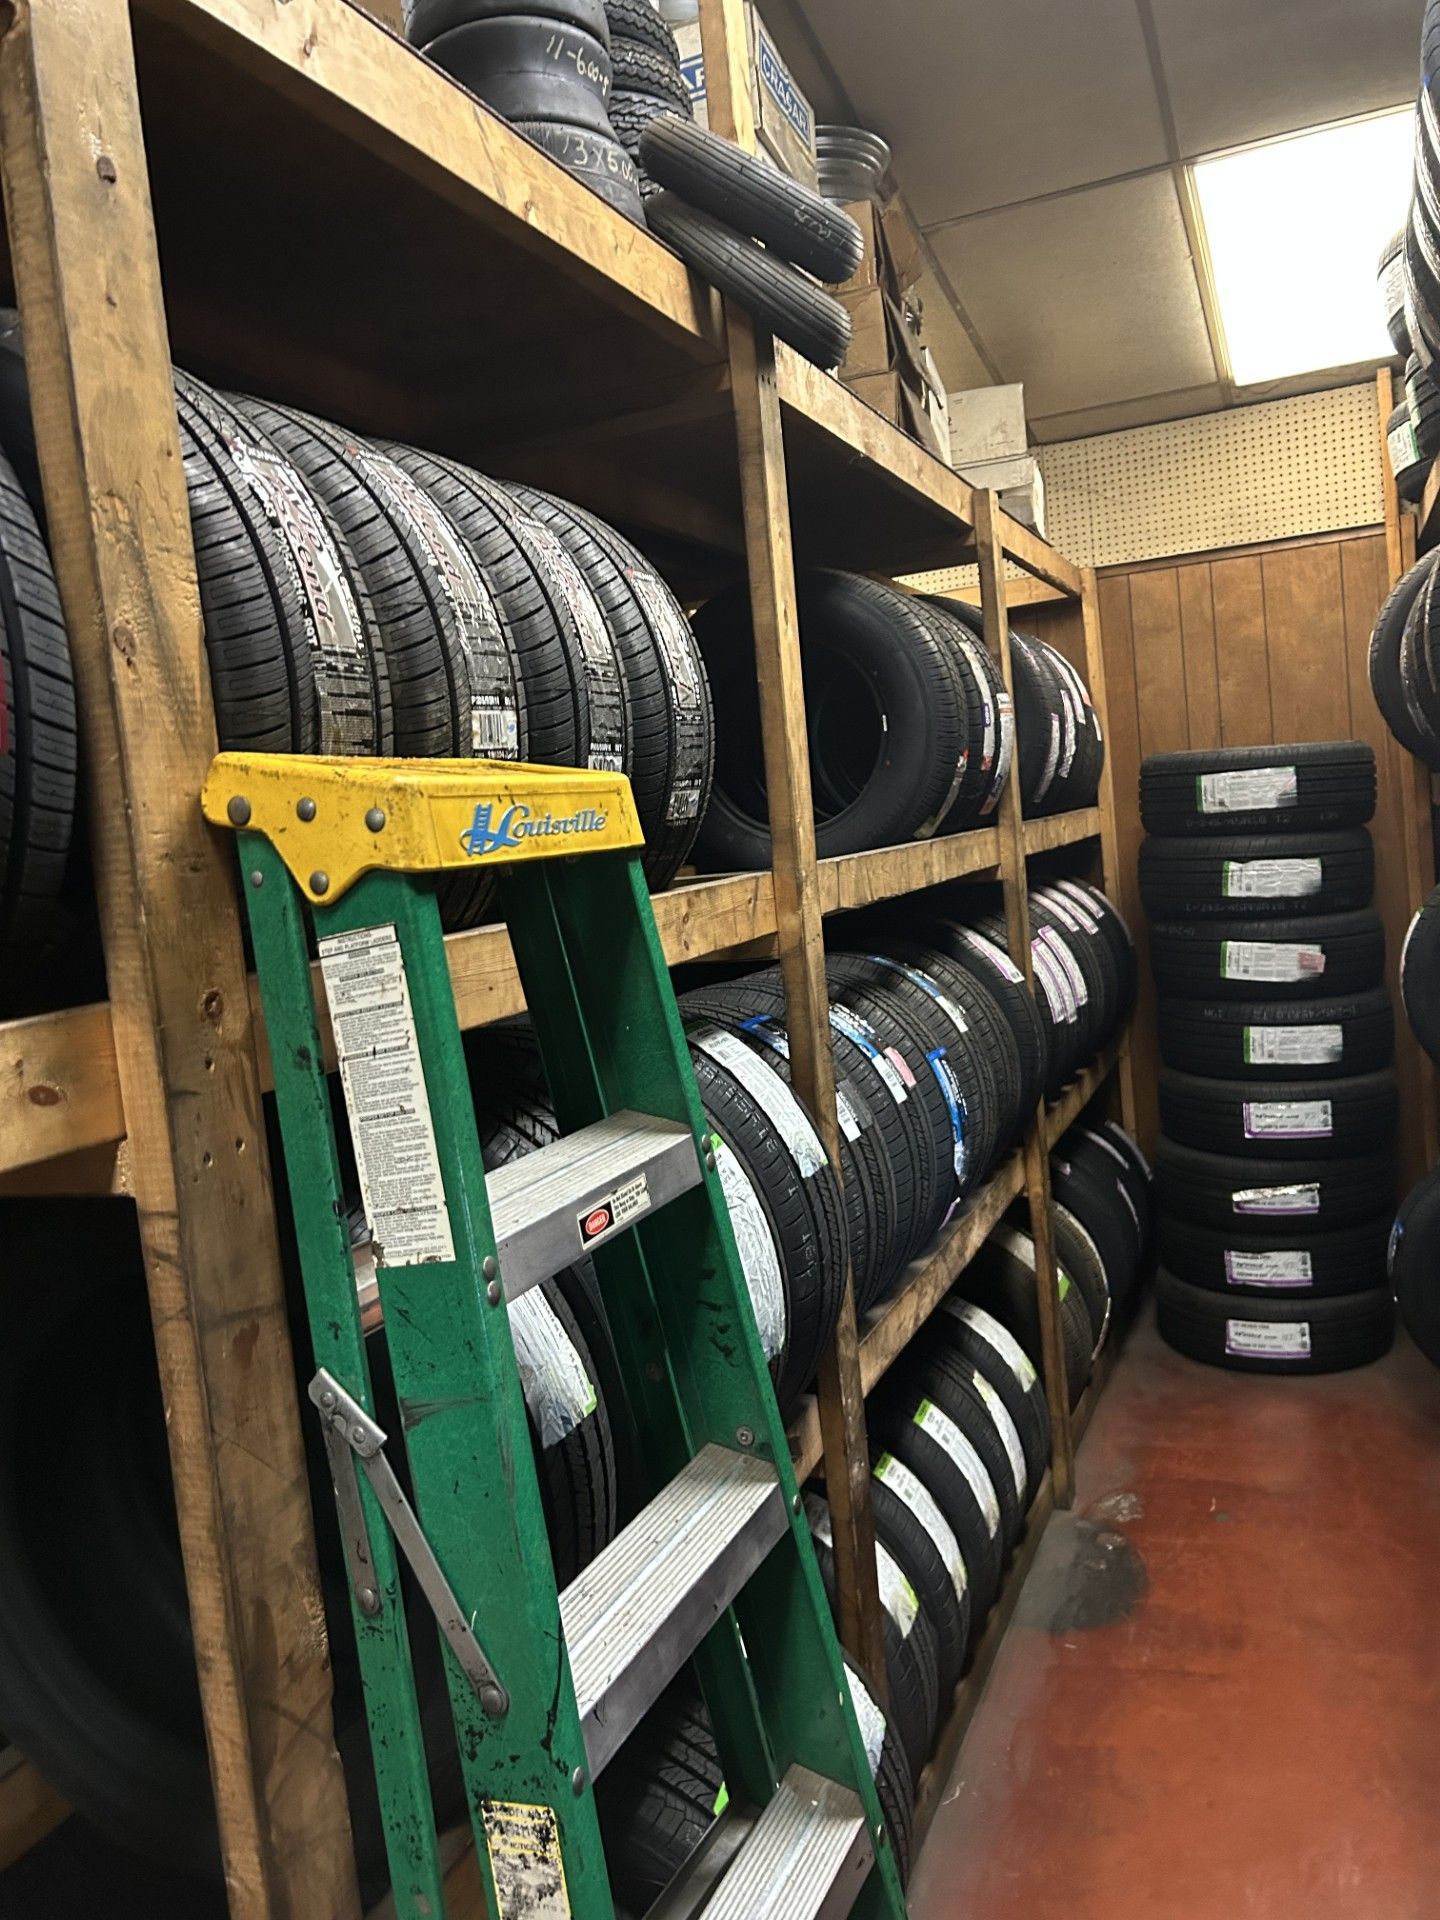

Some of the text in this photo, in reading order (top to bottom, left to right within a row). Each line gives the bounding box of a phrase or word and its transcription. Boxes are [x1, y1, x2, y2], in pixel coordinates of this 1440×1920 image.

[762, 52, 808, 139] CRAGAR
[460, 803, 606, 856] Louisville
[345, 941, 369, 950] PLATFORM
[587, 1213, 606, 1231] DANGER
